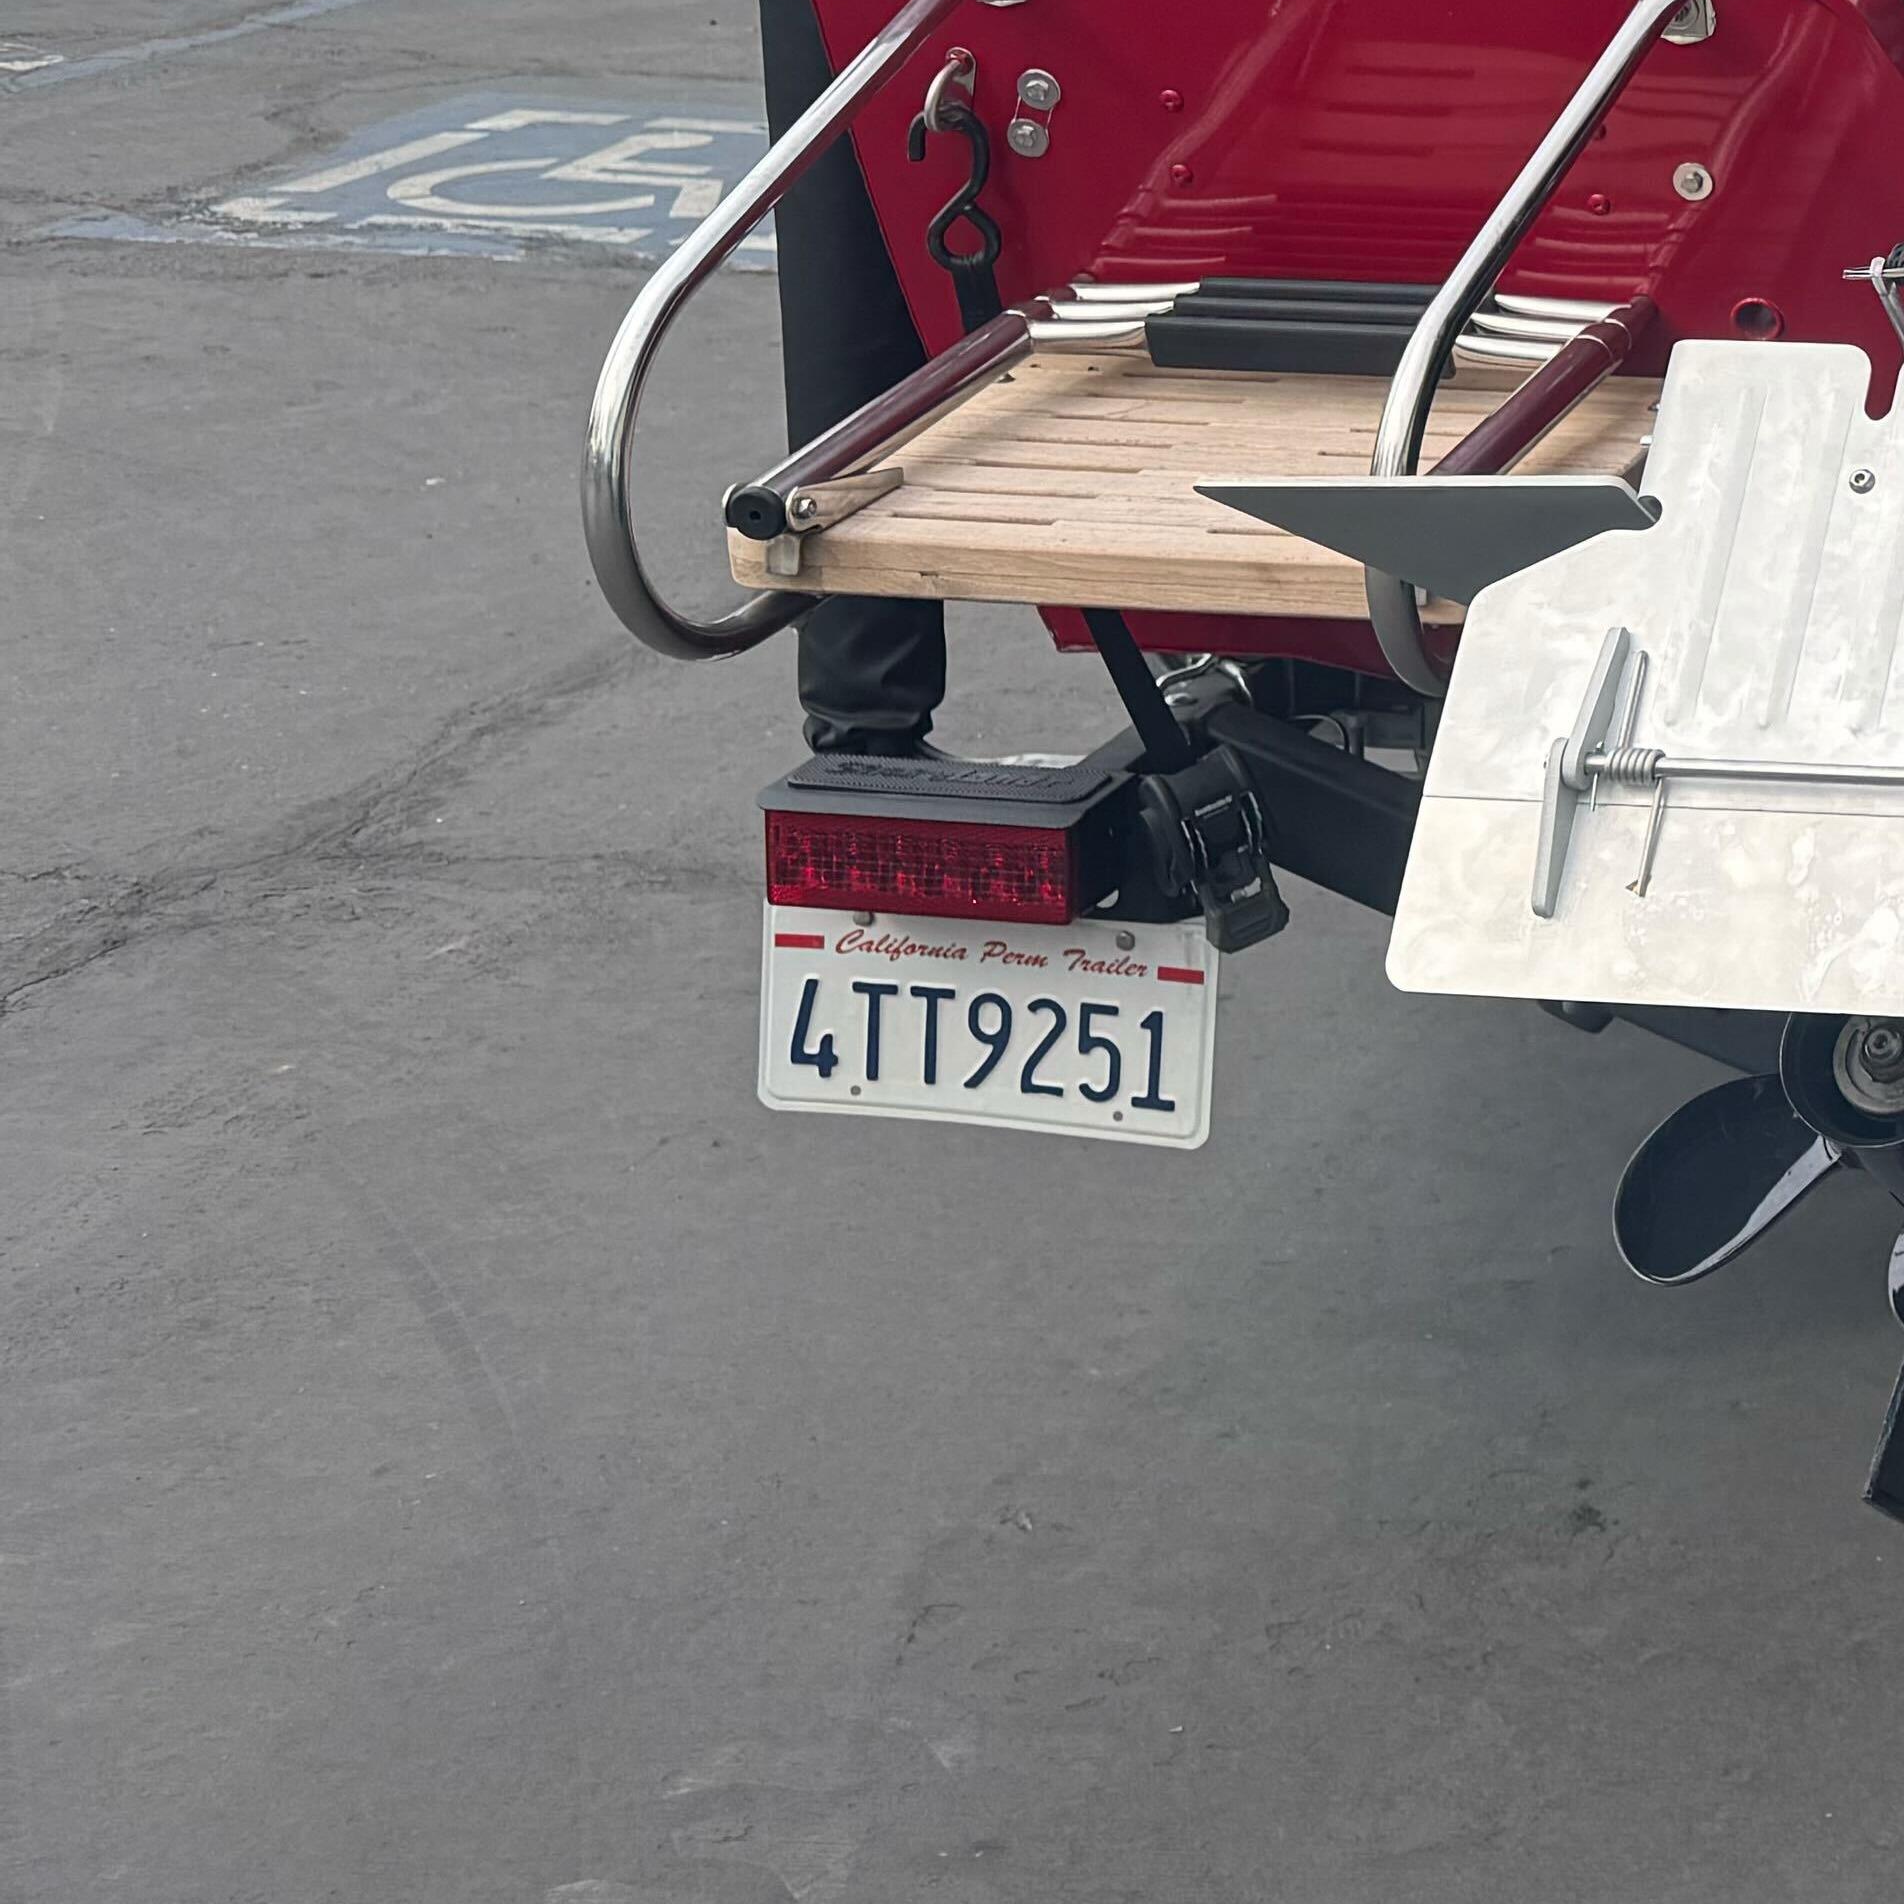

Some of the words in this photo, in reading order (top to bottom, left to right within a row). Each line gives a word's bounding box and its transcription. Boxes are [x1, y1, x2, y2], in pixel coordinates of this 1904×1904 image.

[835, 928, 969, 965] California
[981, 940, 1049, 969] Perm
[1062, 948, 1149, 979] Trailer
[789, 977, 1177, 1112] 4TT9251
